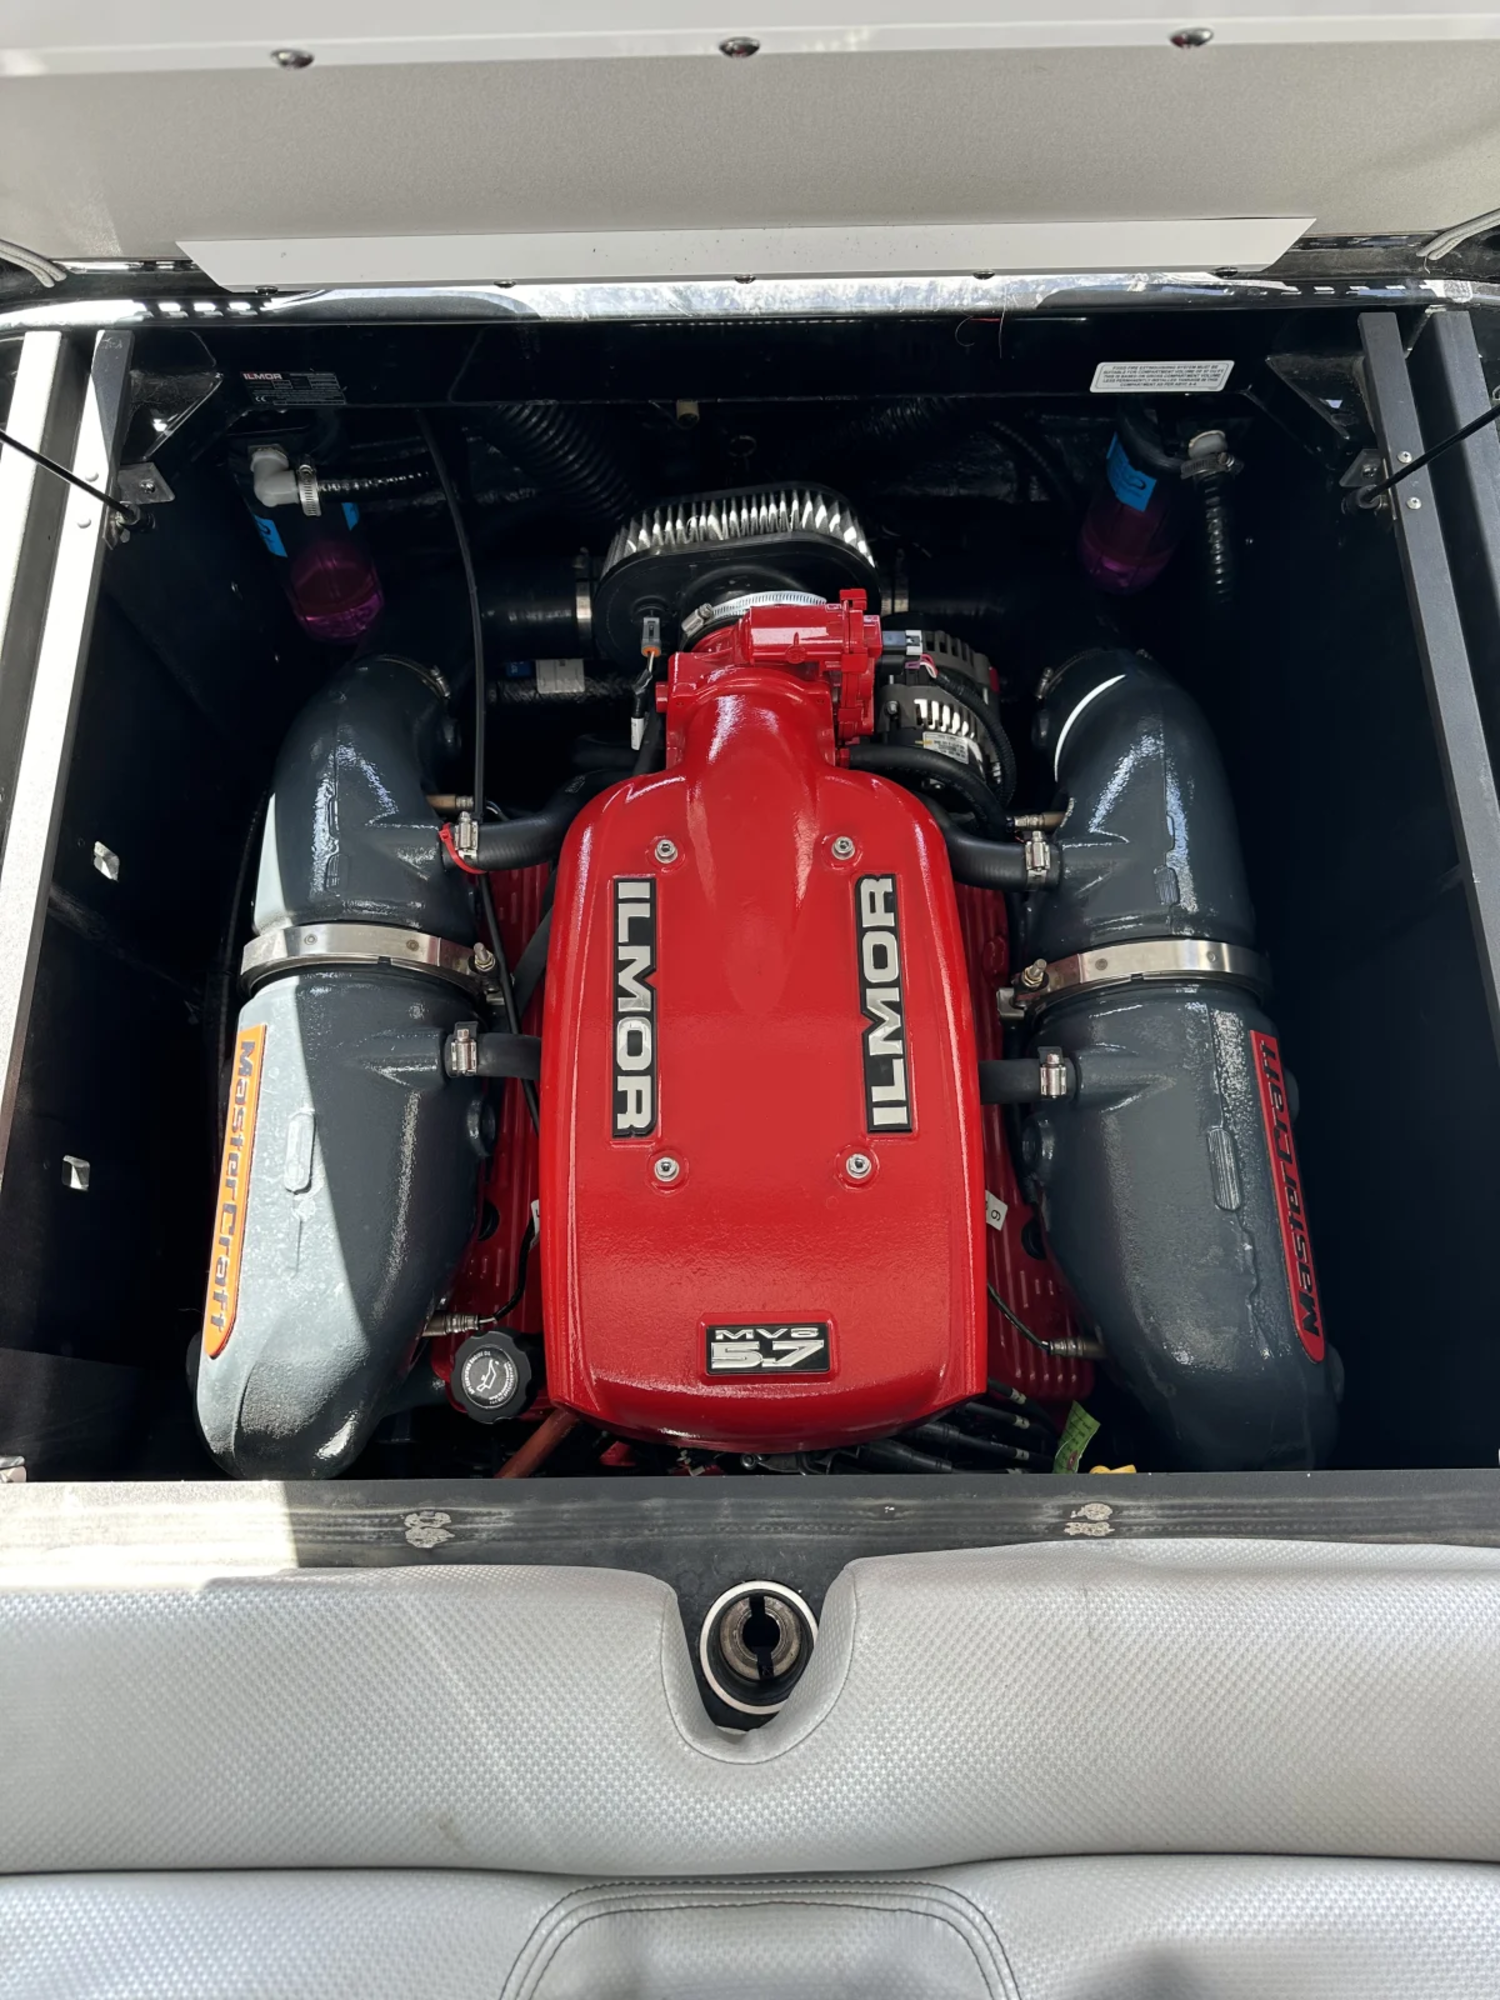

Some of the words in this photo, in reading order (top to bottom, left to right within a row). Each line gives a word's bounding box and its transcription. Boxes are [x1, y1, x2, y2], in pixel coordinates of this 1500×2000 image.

[617, 882, 651, 1129] ILMOR
[860, 878, 908, 1125] ILMOR
[211, 1041, 255, 1332] MasterCraft
[1260, 1039, 1320, 1337] MasterCraft
[711, 1339, 825, 1369] 5.7
